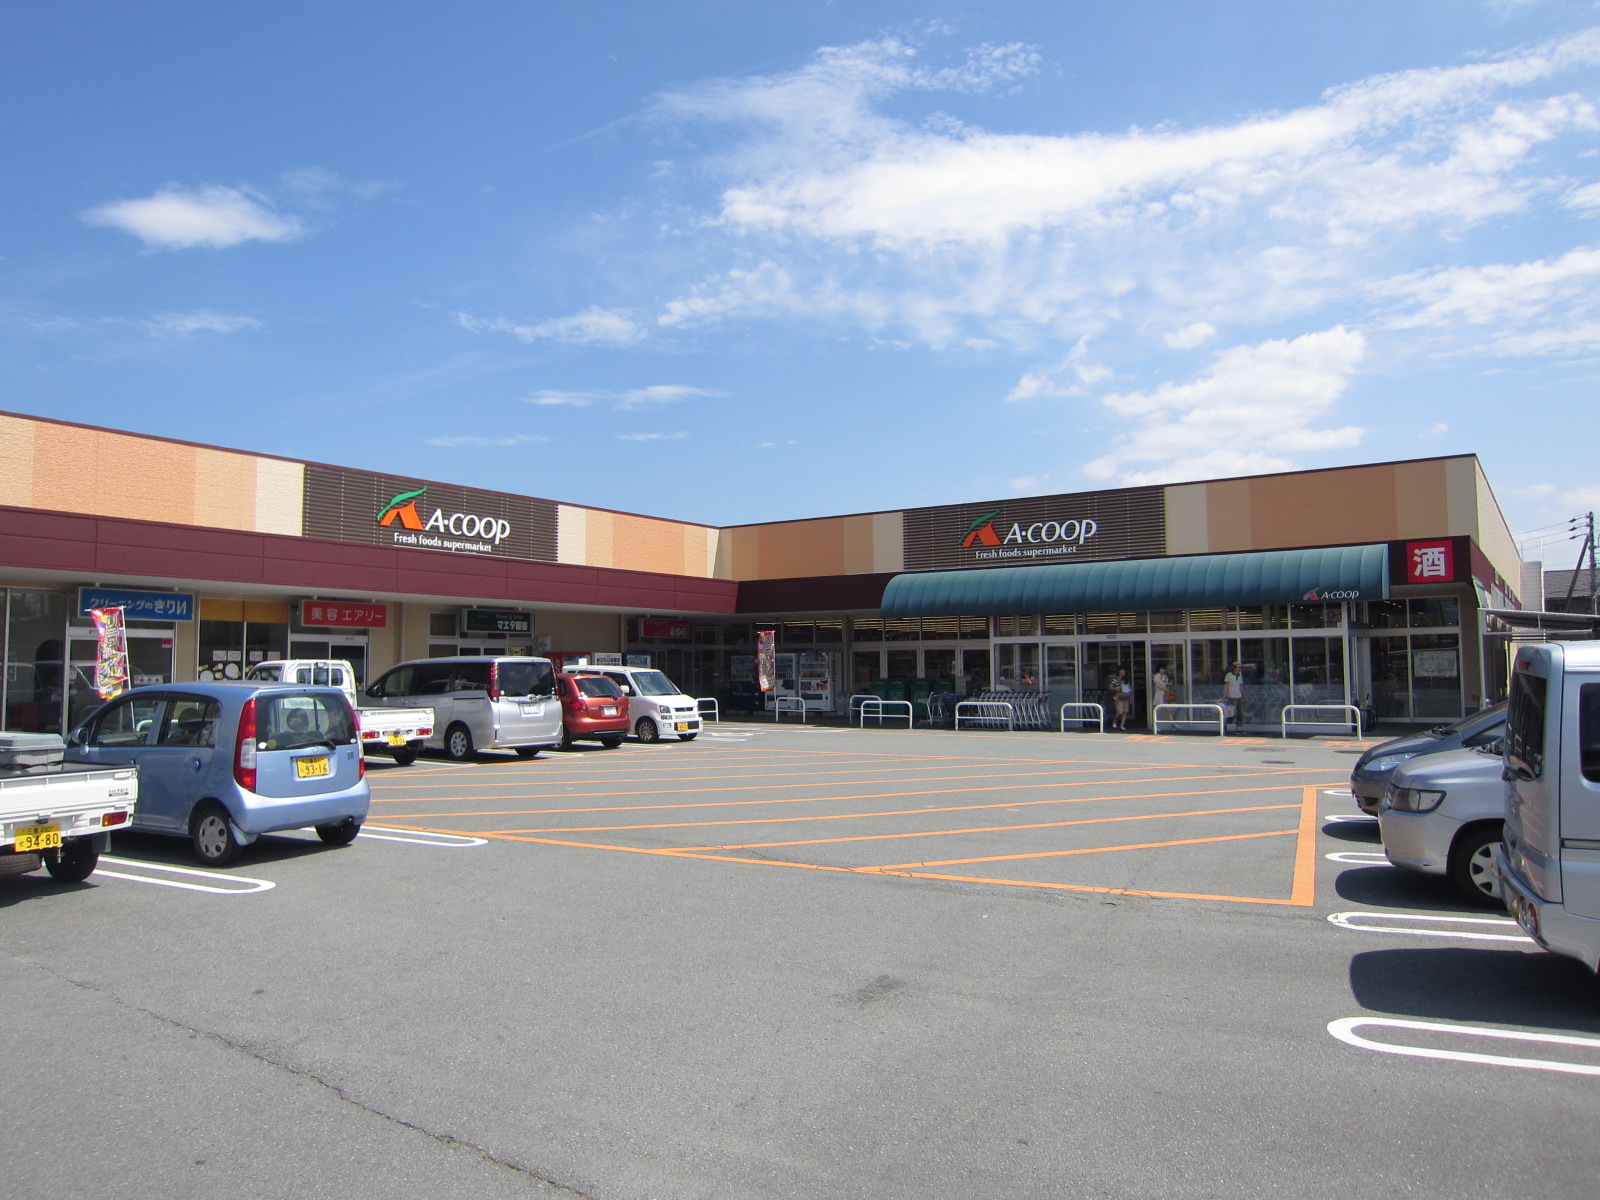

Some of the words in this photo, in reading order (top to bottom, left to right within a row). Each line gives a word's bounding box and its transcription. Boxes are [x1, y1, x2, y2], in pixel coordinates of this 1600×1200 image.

[393, 531, 418, 545] Fresh
[418, 534, 442, 547] foods
[443, 537, 492, 553] supermarket
[975, 549, 998, 559] Fresh
[998, 548, 1022, 557] foods
[1022, 545, 1076, 558] supermarket
[1413, 547, 1446, 577] 酒
[311, 607, 338, 622] 美容
[342, 609, 384, 622] エアリー
[305, 763, 328, 775] 93-16
[26, 833, 59, 848] 94-80
